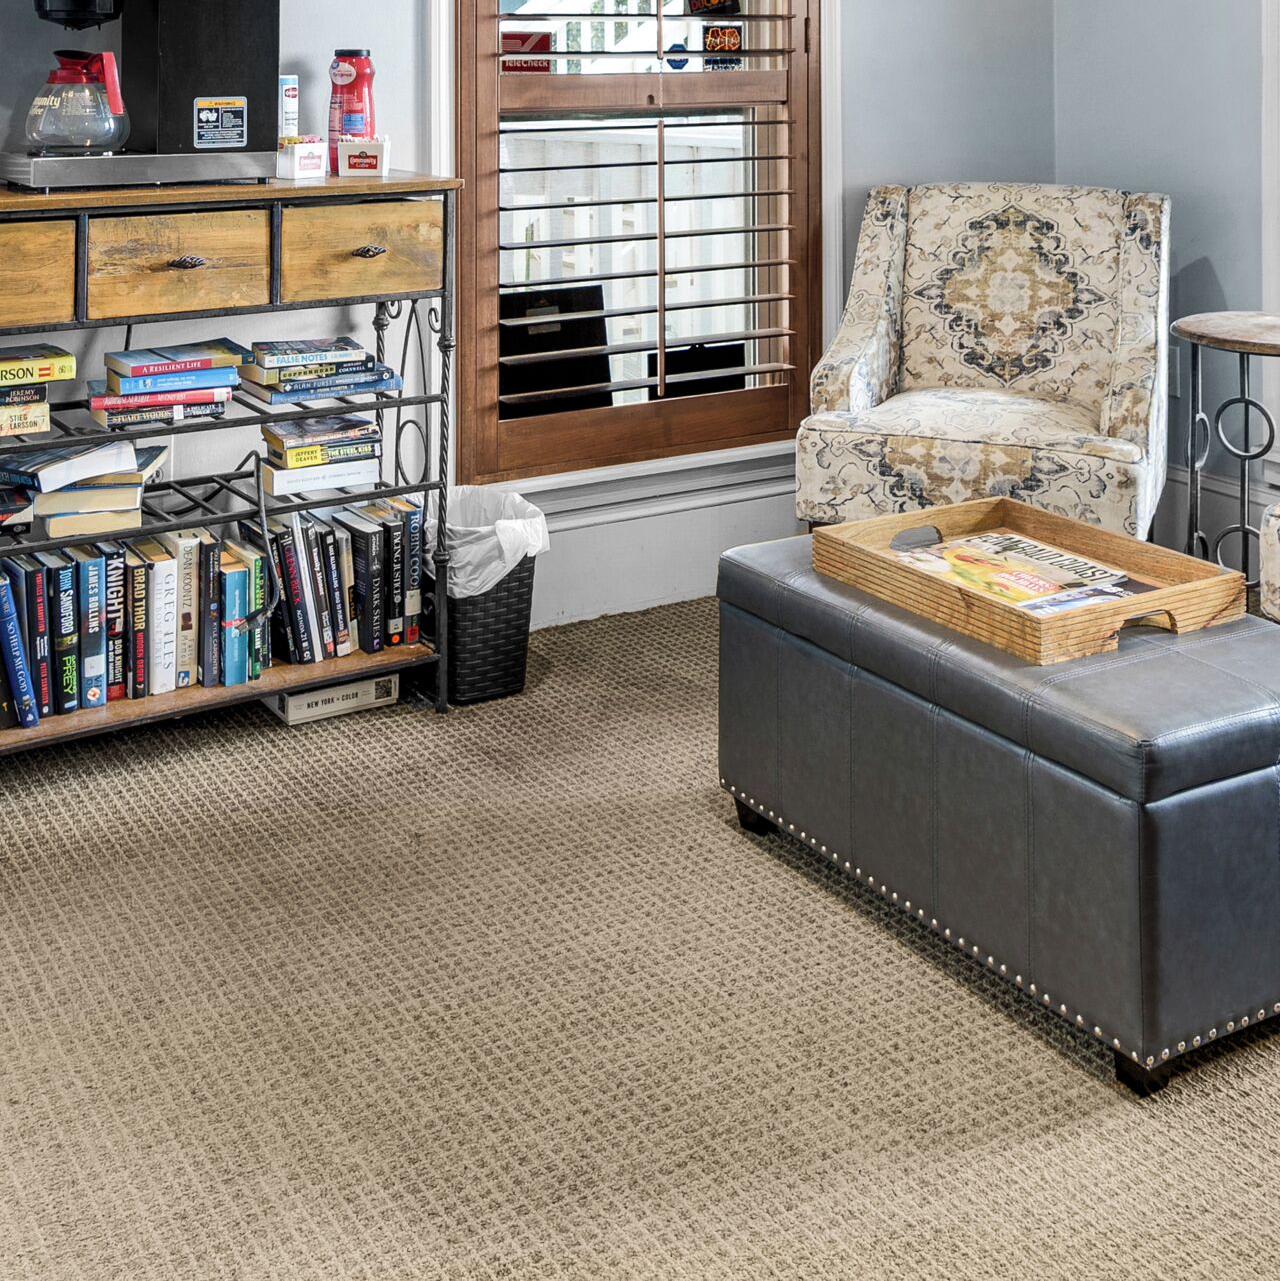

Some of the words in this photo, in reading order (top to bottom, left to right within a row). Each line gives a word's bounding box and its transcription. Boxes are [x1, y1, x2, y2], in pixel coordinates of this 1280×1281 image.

[142, 365, 148, 373] A
[149, 363, 186, 373] RESILIENT
[186, 361, 201, 369] LIFE
[276, 356, 300, 365] FALSE
[300, 353, 328, 364] NOTES
[10, 388, 35, 398] JEREMY
[293, 382, 312, 390] ALAN
[313, 379, 332, 389] FURST
[6, 394, 39, 403] ROBINSON
[9, 414, 28, 422] STIEG
[9, 421, 38, 430] LARSSON
[410, 515, 420, 555] ROBIN
[183, 545, 192, 570] DEAN
[282, 545, 297, 578] GLENN
[1050, 555, 1118, 582] COAST
[59, 568, 72, 590] JOHN
[89, 566, 98, 595] JAMES
[106, 558, 124, 619] KNIGHT
[134, 568, 145, 599] BRAD
[182, 572, 193, 608] KOONTZ
[164, 573, 175, 624] GREG
[289, 579, 303, 605] BECK
[372, 578, 380, 606] DARK
[60, 590, 73, 634] SANDFORD
[88, 597, 99, 634] ROLLINS
[134, 600, 145, 631] THOR
[295, 609, 305, 633] AGENDA
[372, 610, 380, 637] SKIES
[6, 622, 16, 635] SO
[300, 633, 307, 641] 21
[8, 635, 21, 657] HELP
[136, 632, 145, 657] HIDDEN
[163, 632, 175, 670] ILES
[13, 657, 23, 671] ME
[62, 657, 72, 694] PREY
[136, 658, 145, 682] ORDER
[16, 670, 28, 692] GOD
[306, 701, 319, 709] NEW
[321, 697, 334, 706] YORK
[341, 692, 359, 701] COLOR
